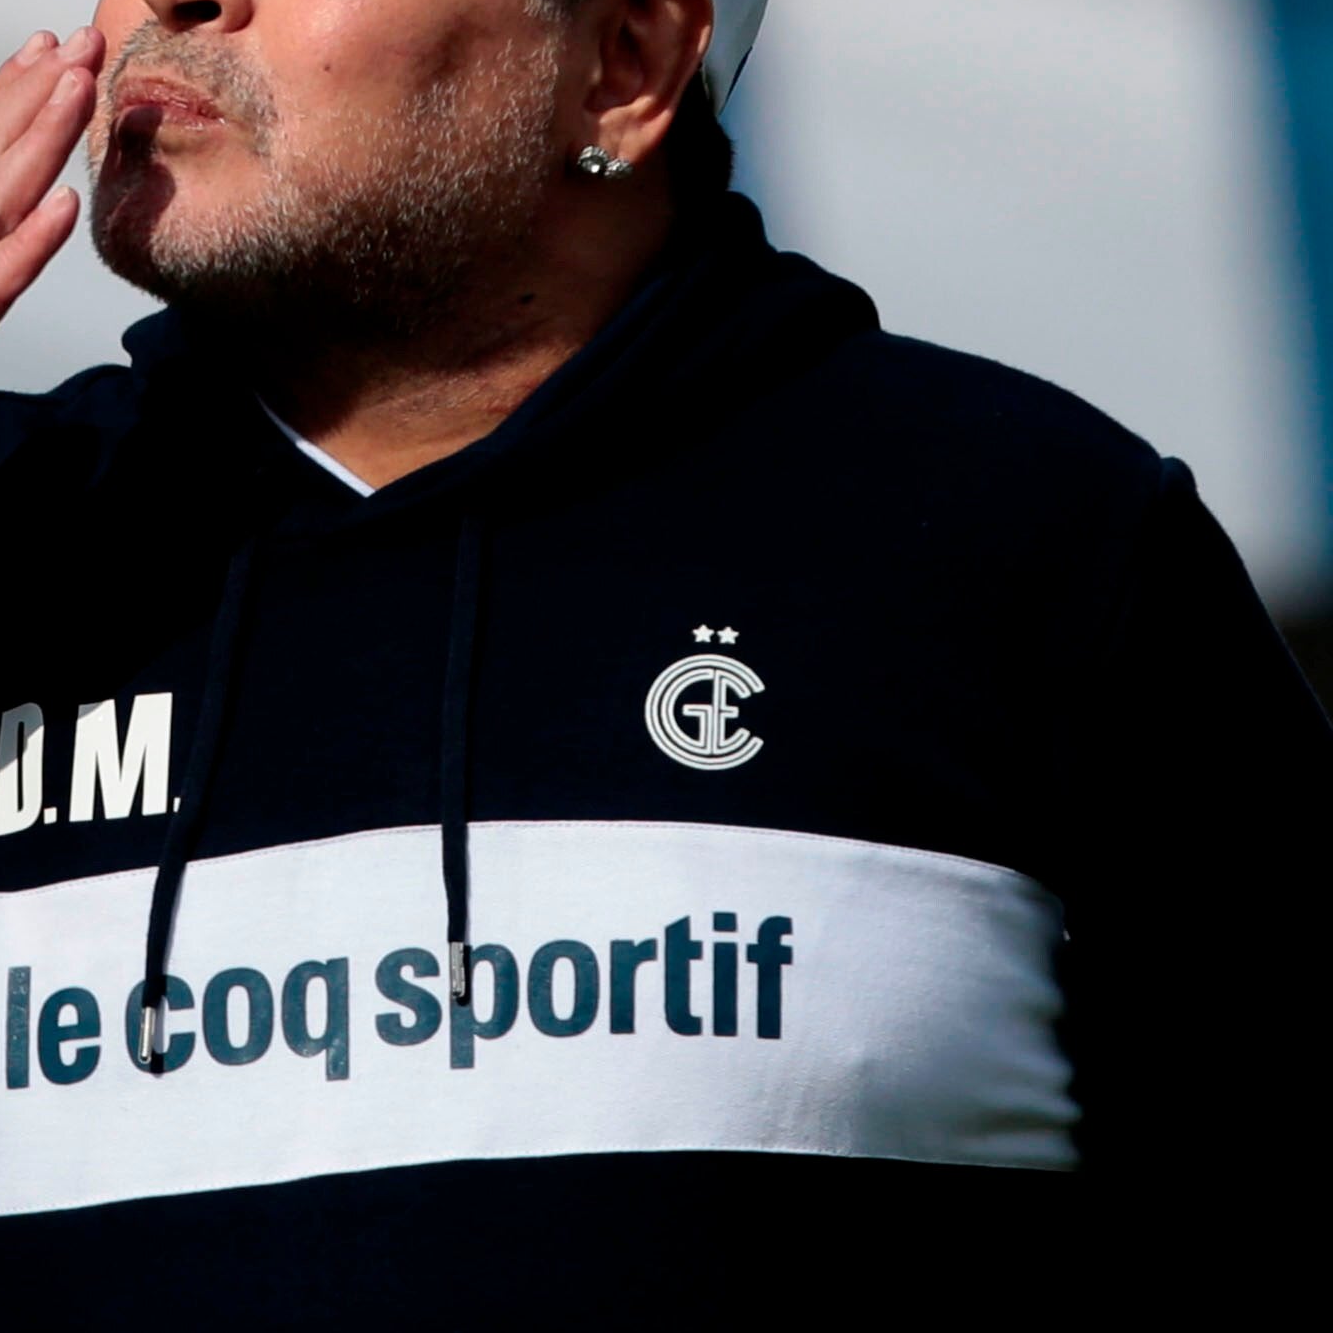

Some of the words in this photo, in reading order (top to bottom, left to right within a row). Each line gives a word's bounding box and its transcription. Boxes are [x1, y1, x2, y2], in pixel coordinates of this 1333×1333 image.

[6, 965, 102, 1089] le
[124, 957, 351, 1081] coq
[374, 911, 794, 1069] sportif
